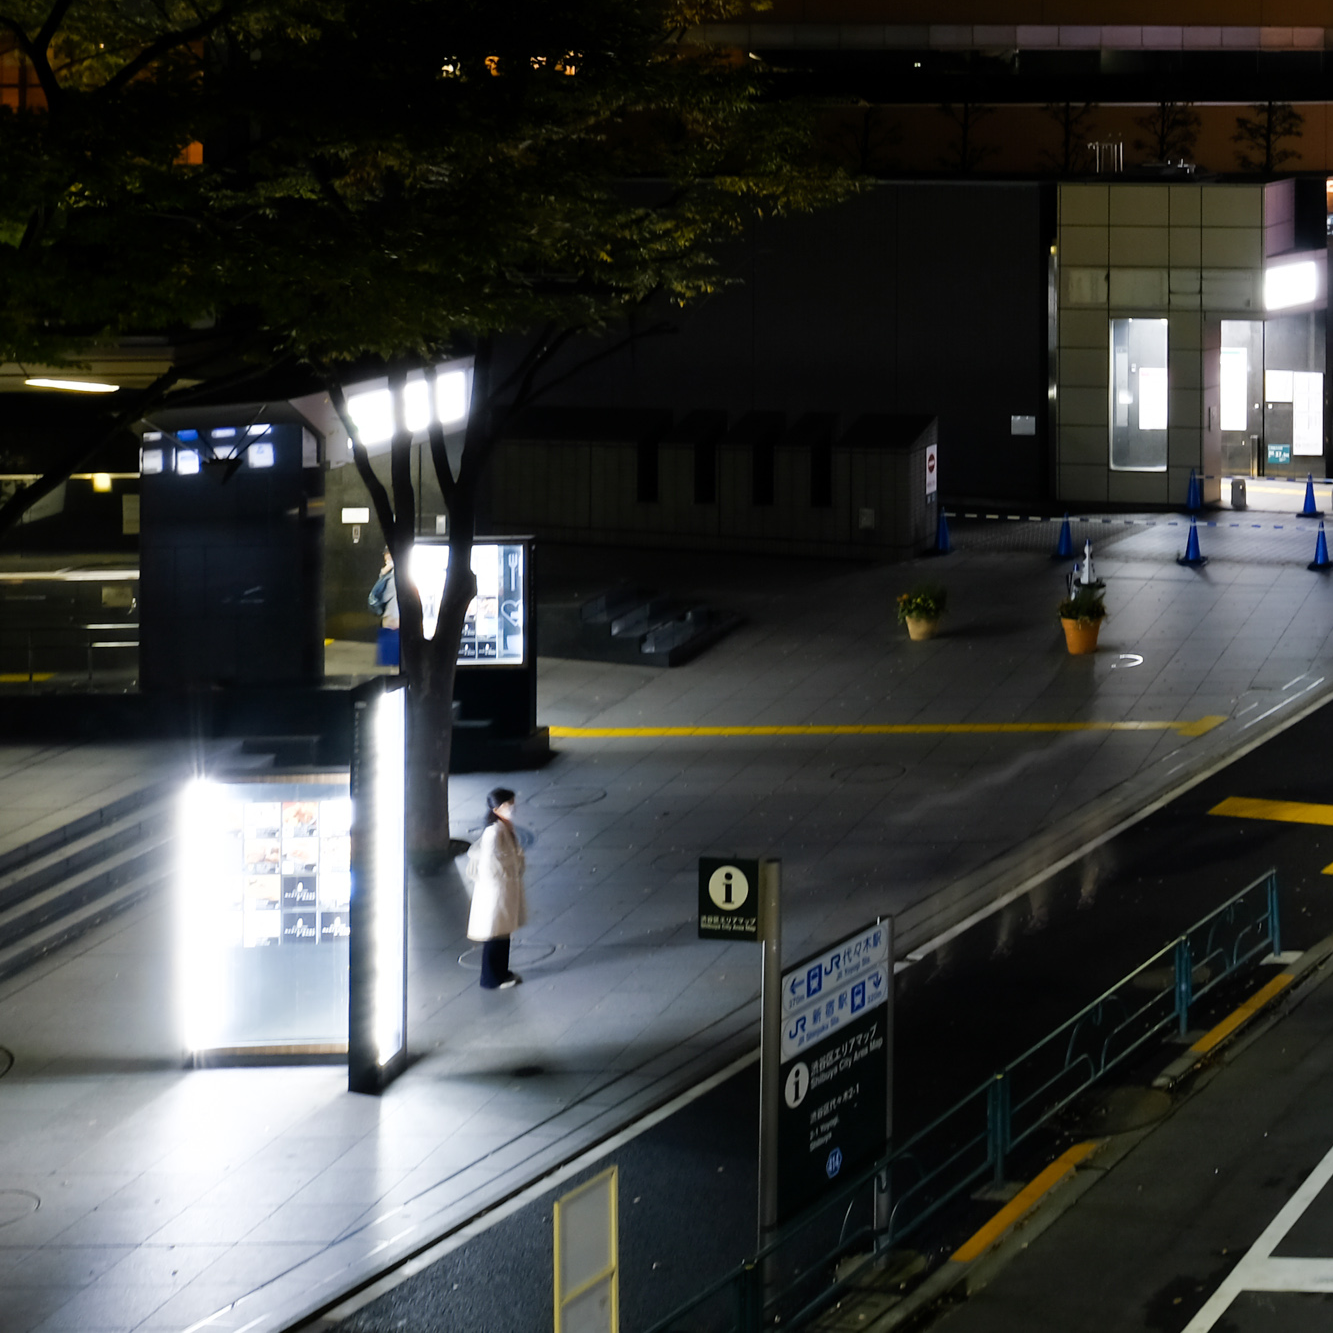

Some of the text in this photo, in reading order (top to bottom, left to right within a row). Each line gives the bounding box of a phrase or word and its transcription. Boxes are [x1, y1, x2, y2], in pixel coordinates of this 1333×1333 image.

[810, 1020, 878, 1078] 渋谷区エリアマップ
[838, 1057, 853, 1072] City
[870, 1036, 884, 1052] Map
